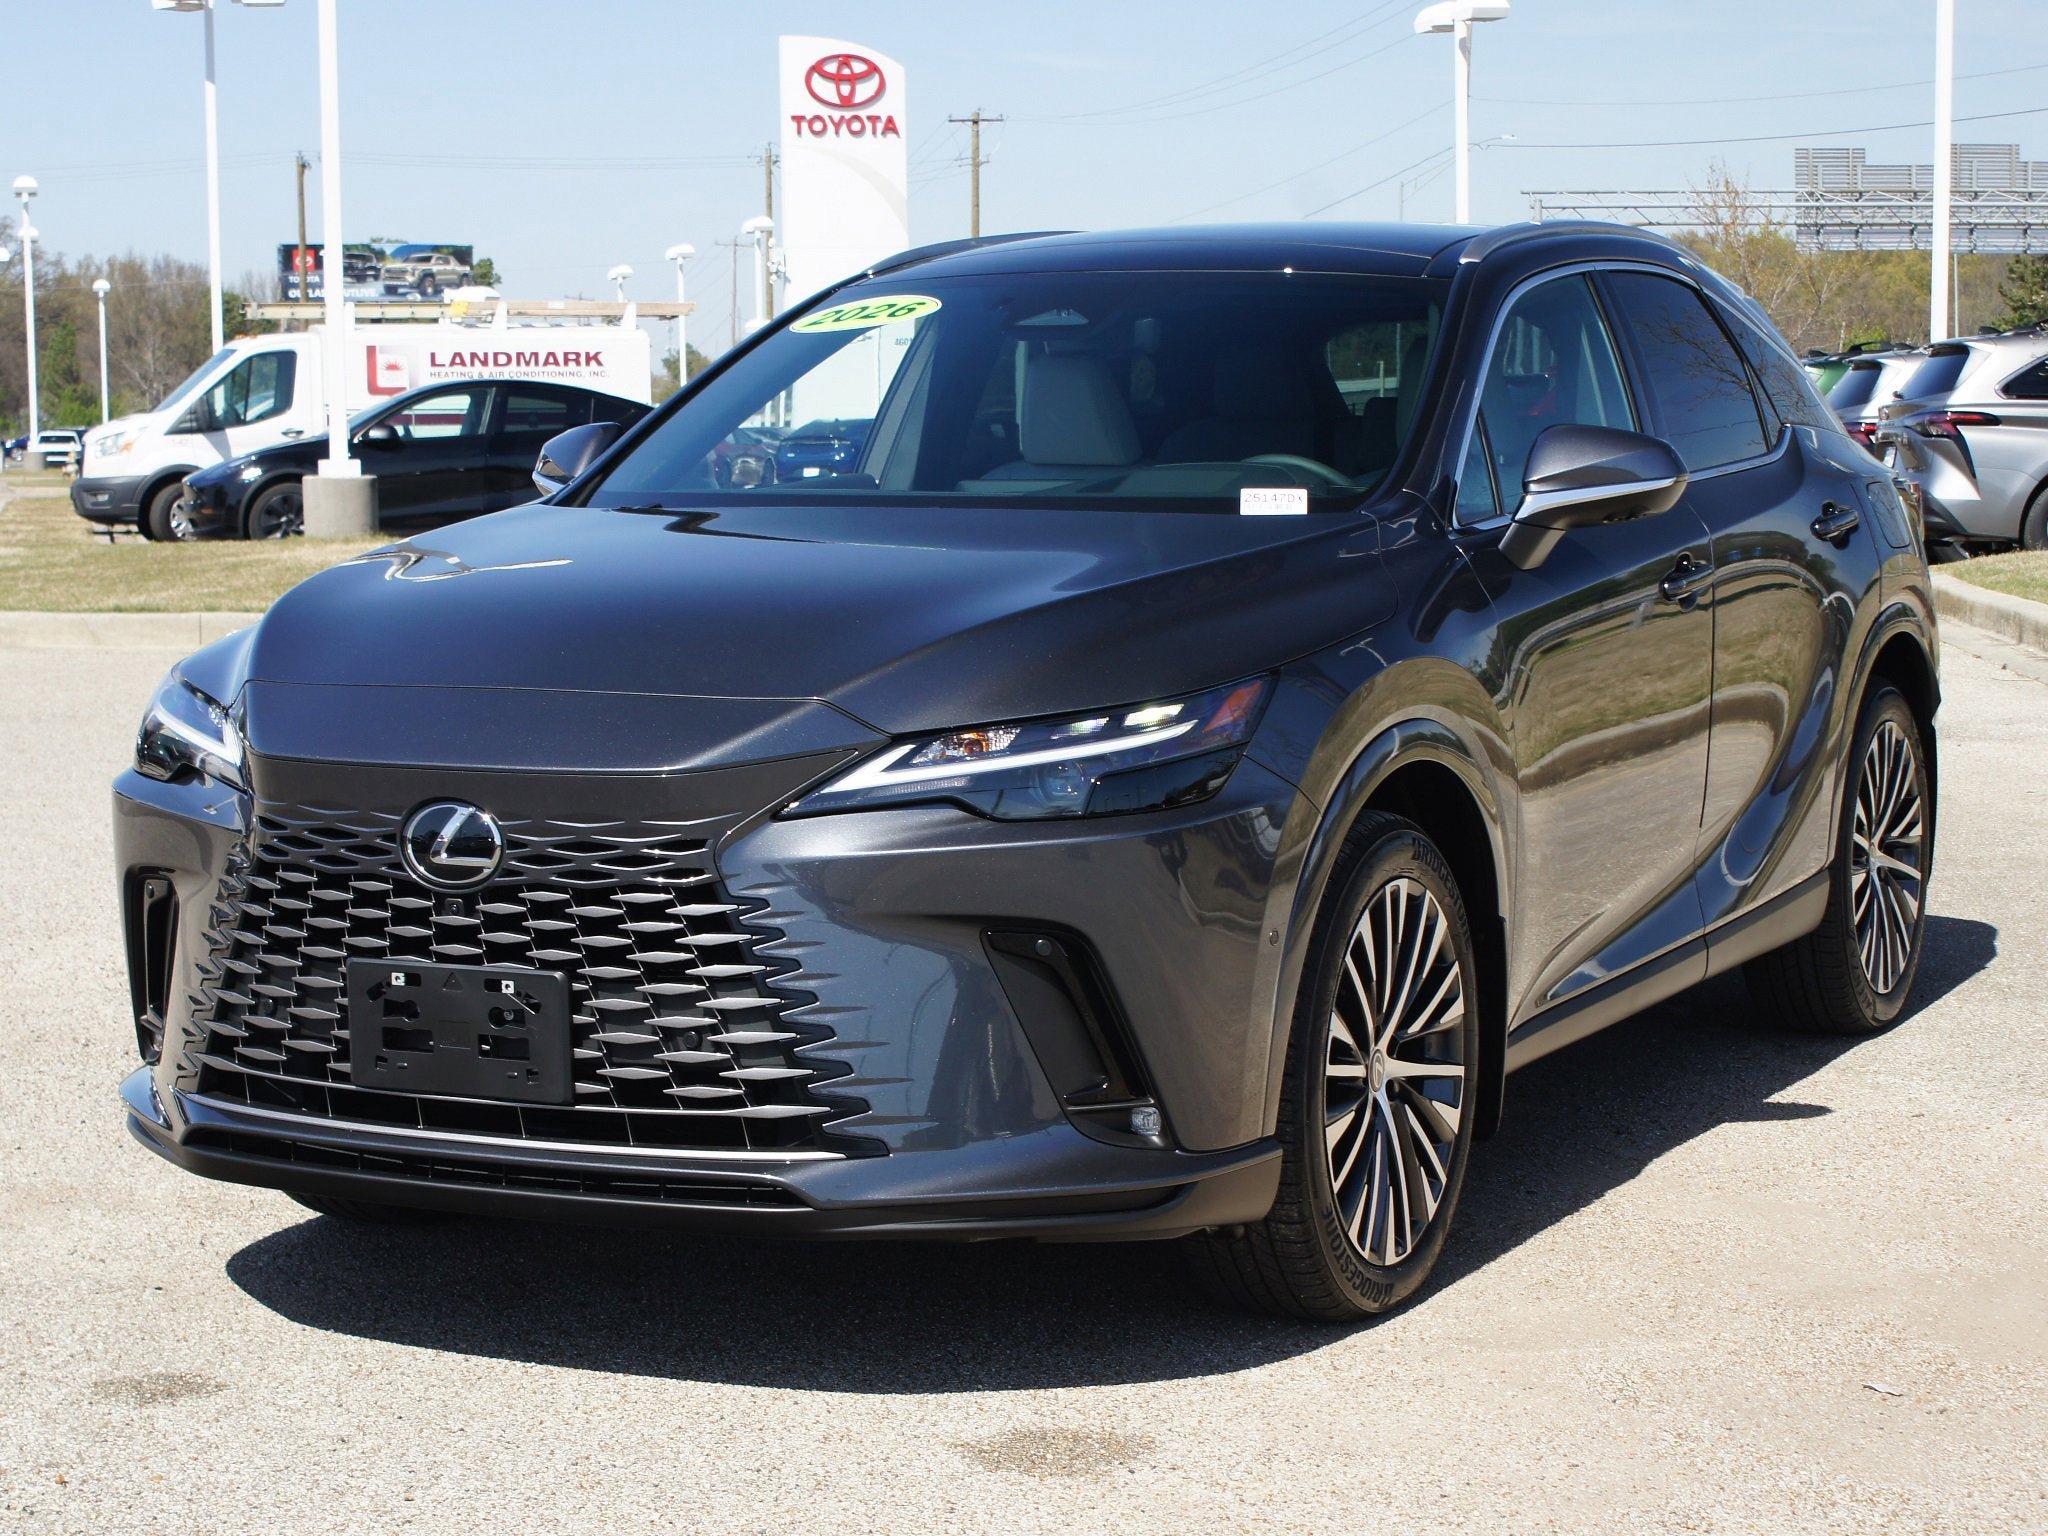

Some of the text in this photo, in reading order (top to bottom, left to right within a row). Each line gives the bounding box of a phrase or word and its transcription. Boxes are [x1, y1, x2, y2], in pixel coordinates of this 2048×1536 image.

[791, 115, 900, 138] TOYOTA
[802, 301, 926, 328] 2026
[430, 351, 605, 367] LANDMARK
[430, 371, 474, 379] HEATING
[477, 371, 484, 379] &
[488, 371, 505, 379] AIR
